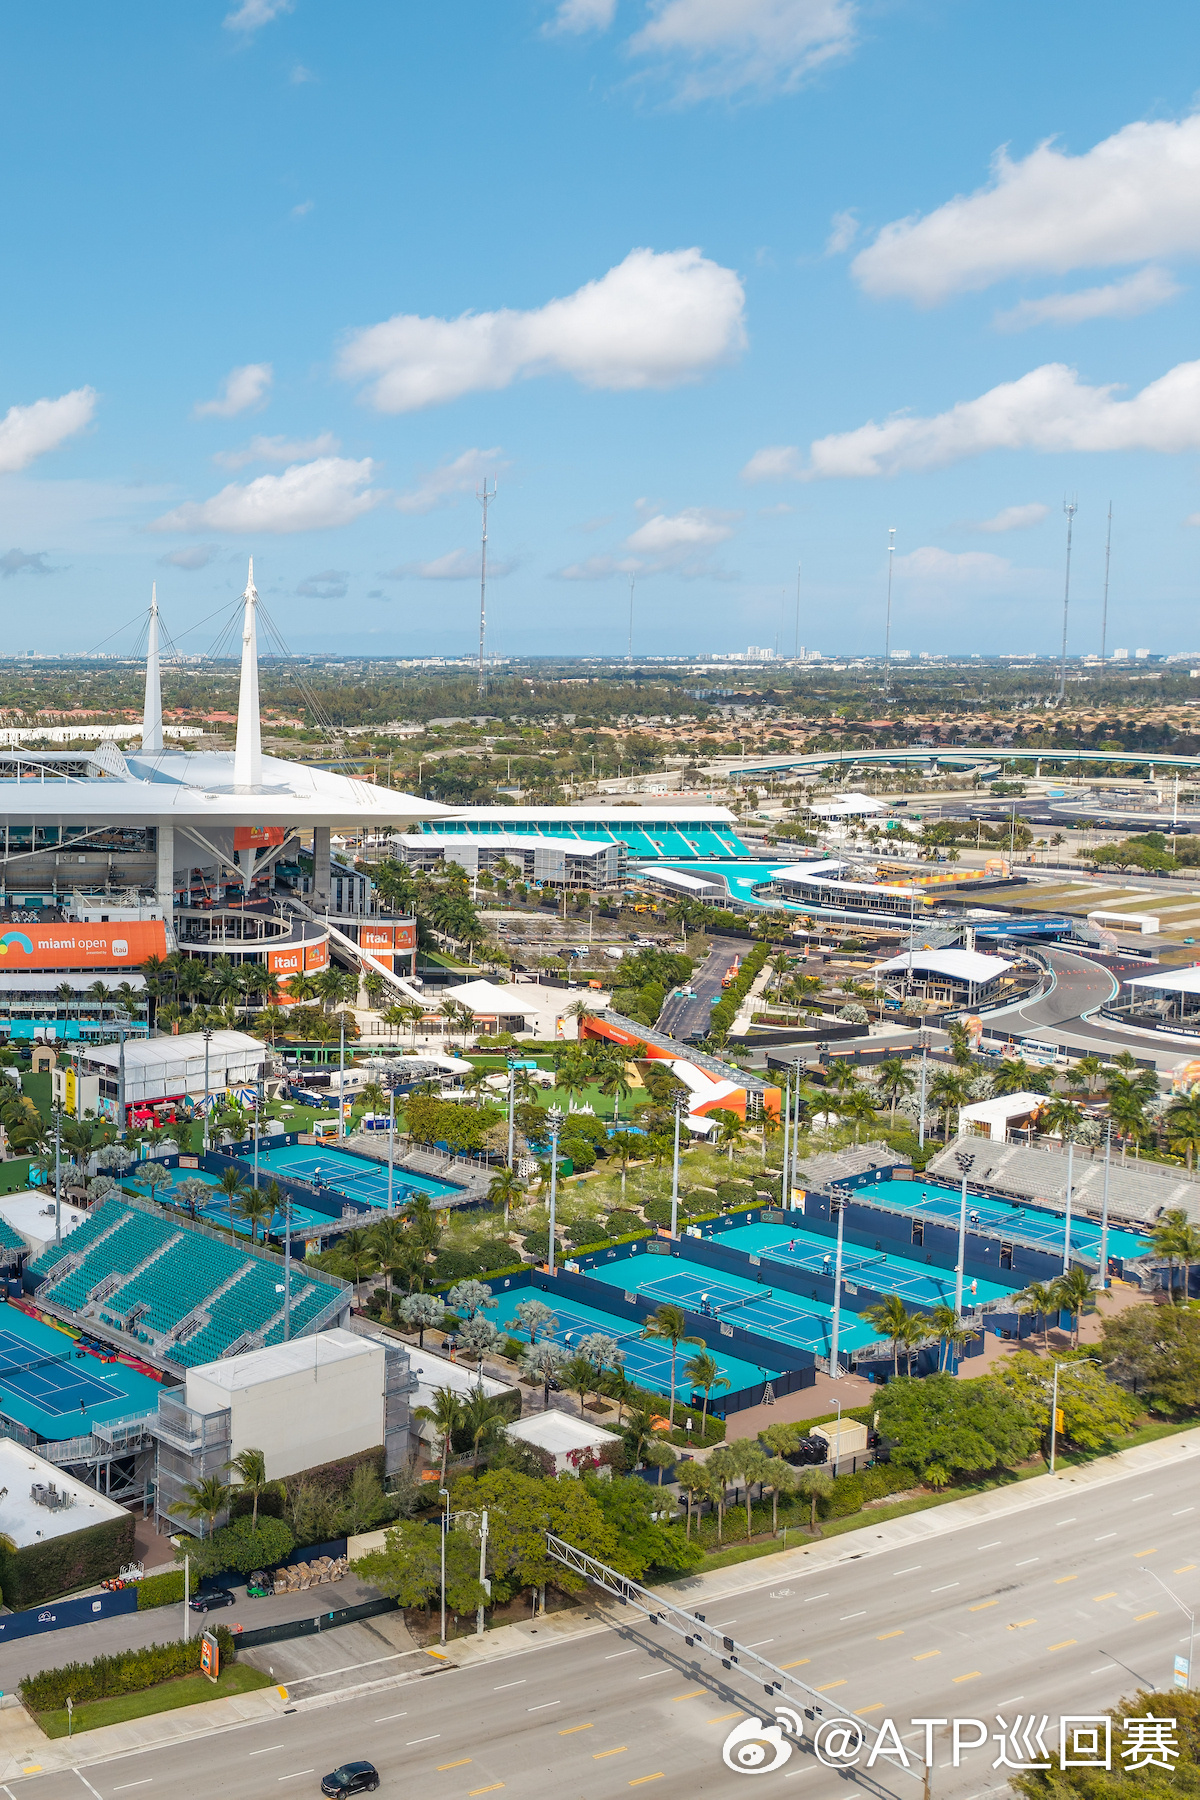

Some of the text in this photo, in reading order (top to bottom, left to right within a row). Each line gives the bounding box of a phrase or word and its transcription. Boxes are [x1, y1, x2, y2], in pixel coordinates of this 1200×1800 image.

[38, 937, 107, 951] miami open
[366, 932, 388, 944] itaú
[274, 955, 298, 969] itaú
[762, 1213, 774, 1221] C2
[647, 1243, 660, 1252] C3
